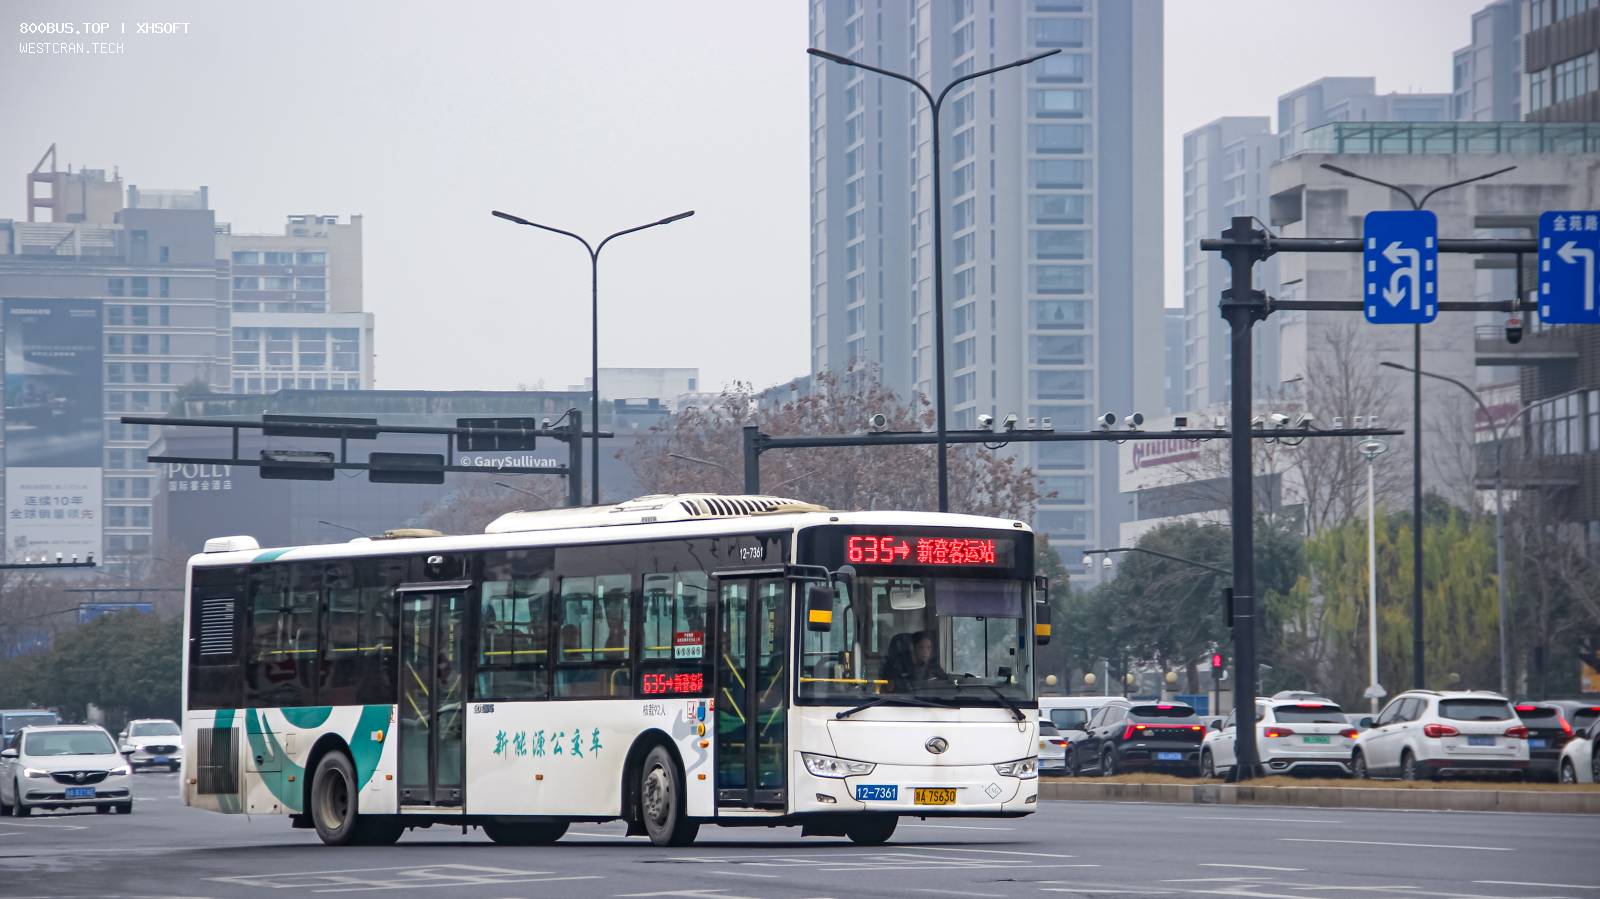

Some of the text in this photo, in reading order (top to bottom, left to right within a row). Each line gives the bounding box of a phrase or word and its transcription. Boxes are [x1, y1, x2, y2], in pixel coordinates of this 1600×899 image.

[1553, 214, 1598, 231] 金苑路
[740, 546, 763, 560] 12-7361
[849, 536, 995, 563] 635 新登客运站
[492, 727, 603, 760] 新能源公交车
[857, 785, 897, 799] 12-7361
